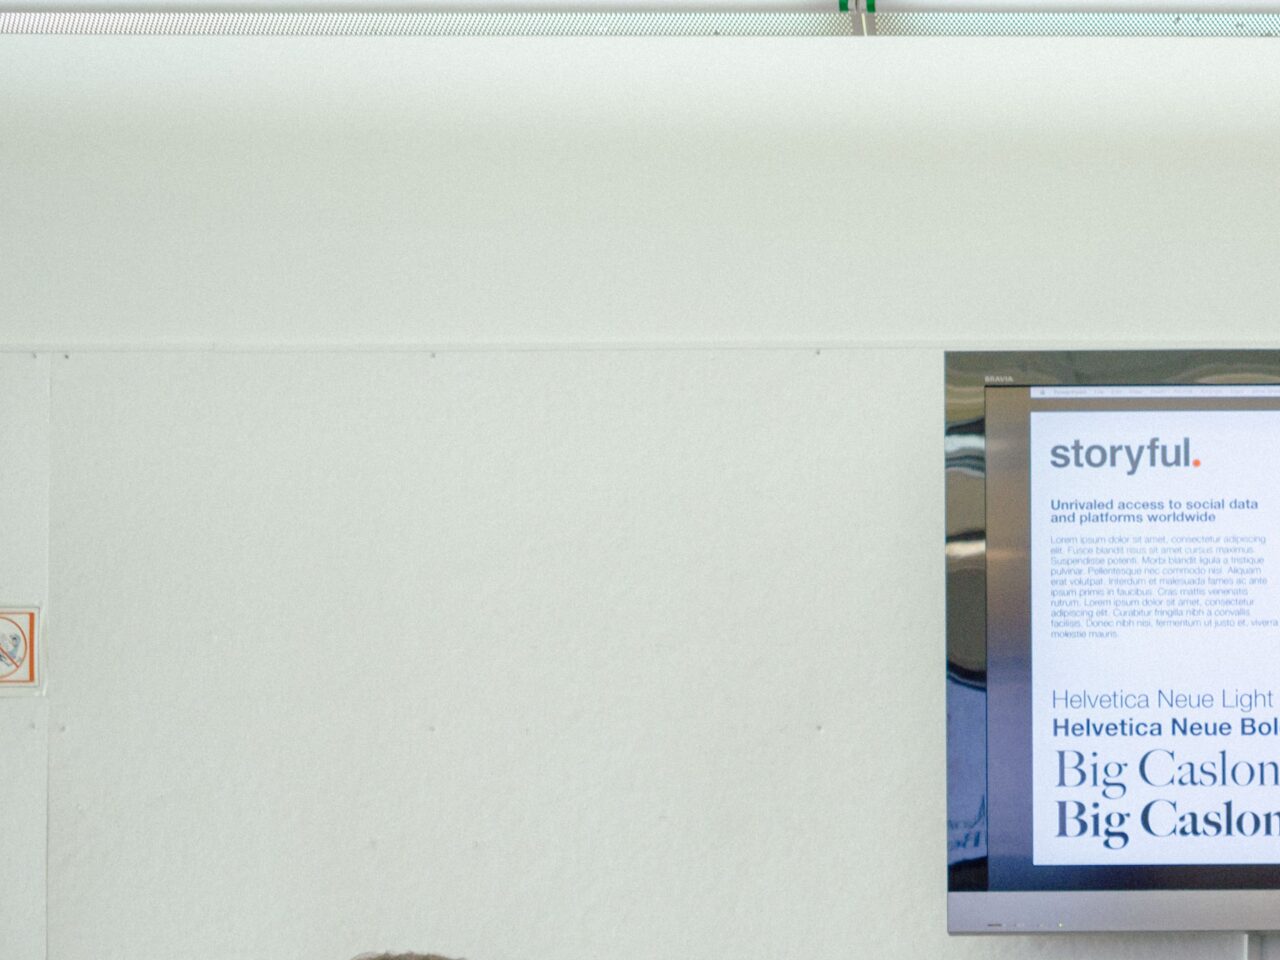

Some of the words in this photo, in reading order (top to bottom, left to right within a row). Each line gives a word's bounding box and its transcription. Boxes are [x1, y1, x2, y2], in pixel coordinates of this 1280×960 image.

[984, 375, 1013, 383] BRAVIA
[1050, 436, 1201, 476] storyful.
[1051, 499, 1113, 510] Unrivaled
[1118, 502, 1164, 510] access
[1169, 499, 1182, 510] to
[1186, 499, 1225, 510] social
[1229, 499, 1258, 510] data
[1051, 512, 1075, 523] and
[1079, 512, 1143, 525] platforms
[1148, 512, 1216, 523] worldwide
[1052, 689, 1149, 709] Helvetica
[1158, 689, 1214, 709] Neue
[1222, 689, 1274, 713] Light
[1052, 717, 1162, 736] Helvetica
[1171, 717, 1231, 736] Neue
[1056, 748, 1128, 800] Big
[1138, 748, 1280, 787] Caslon
[1055, 798, 1130, 849] Big
